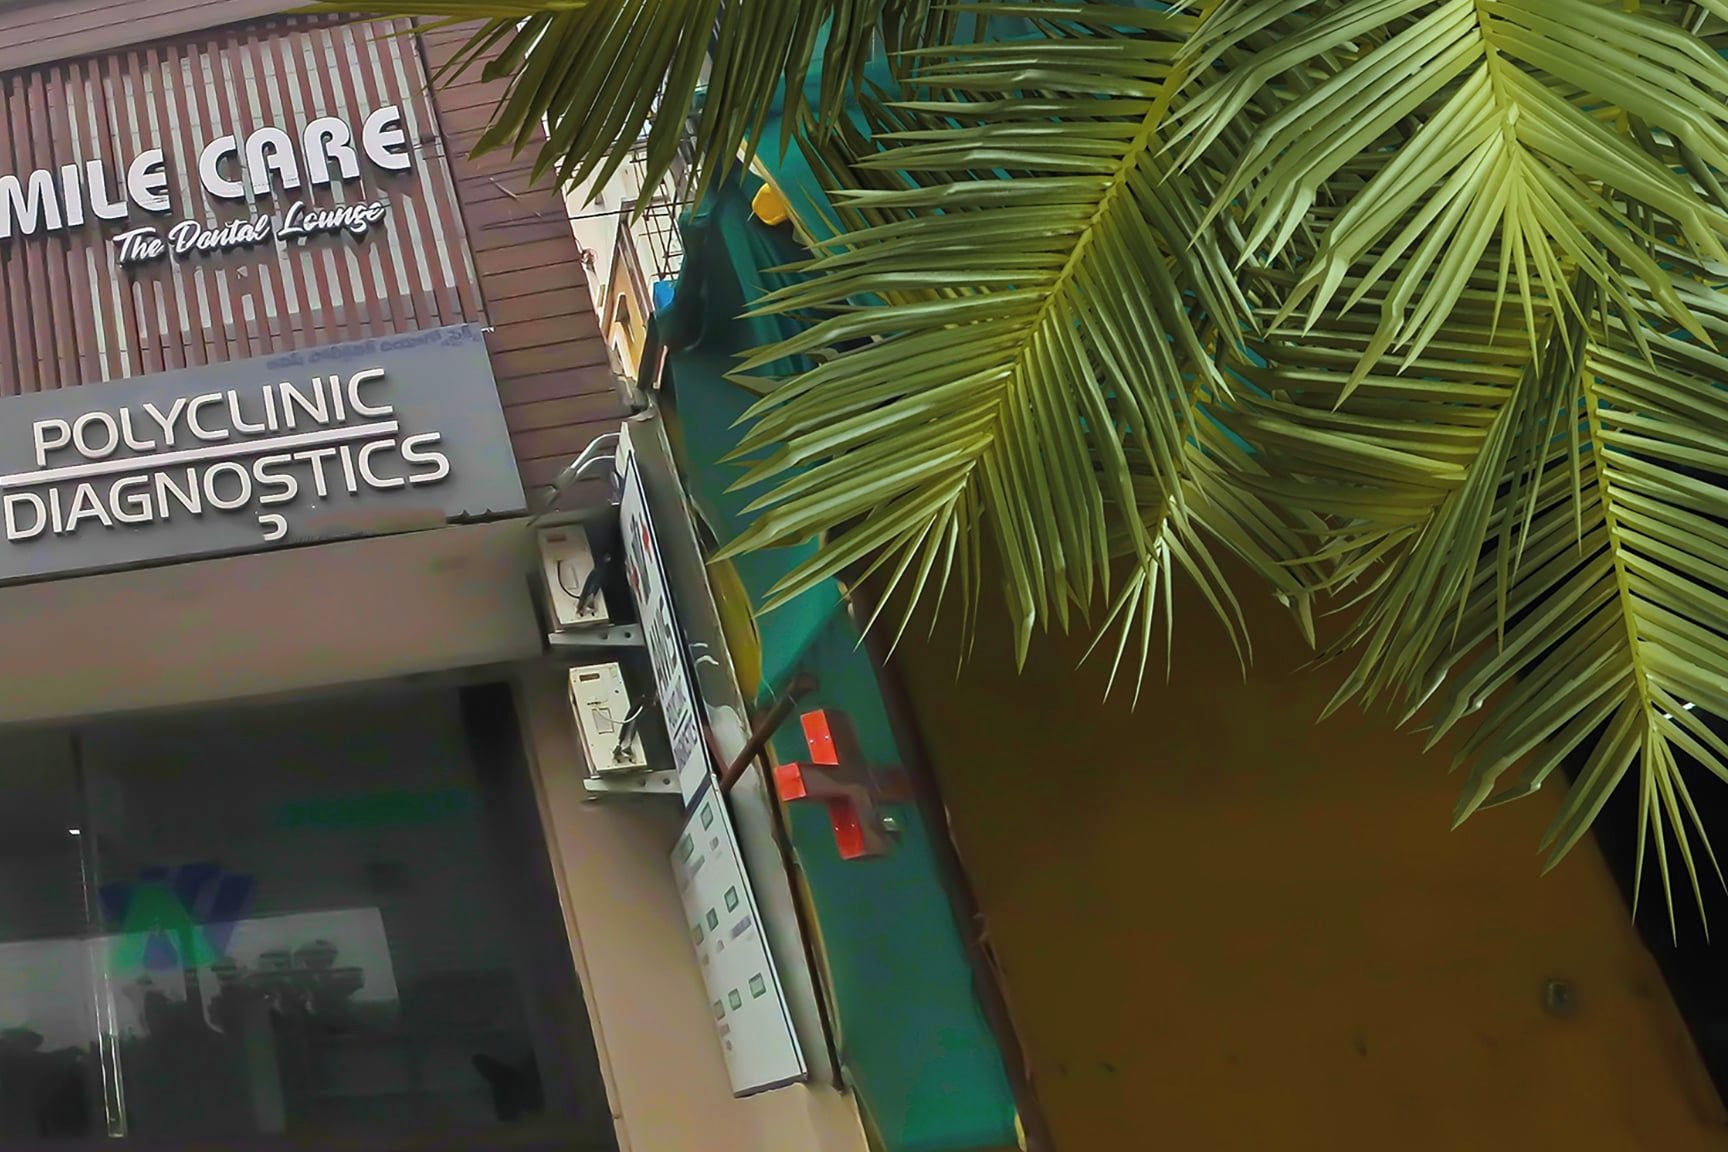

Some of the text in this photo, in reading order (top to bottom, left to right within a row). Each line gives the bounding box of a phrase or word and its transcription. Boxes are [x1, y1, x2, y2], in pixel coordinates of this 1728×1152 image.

[199, 105, 412, 200] CARE
[113, 200, 386, 268] The Dental Lounge
[32, 367, 394, 467] POLYCLINIC
[2, 431, 450, 542] DIAGNOSTICS
